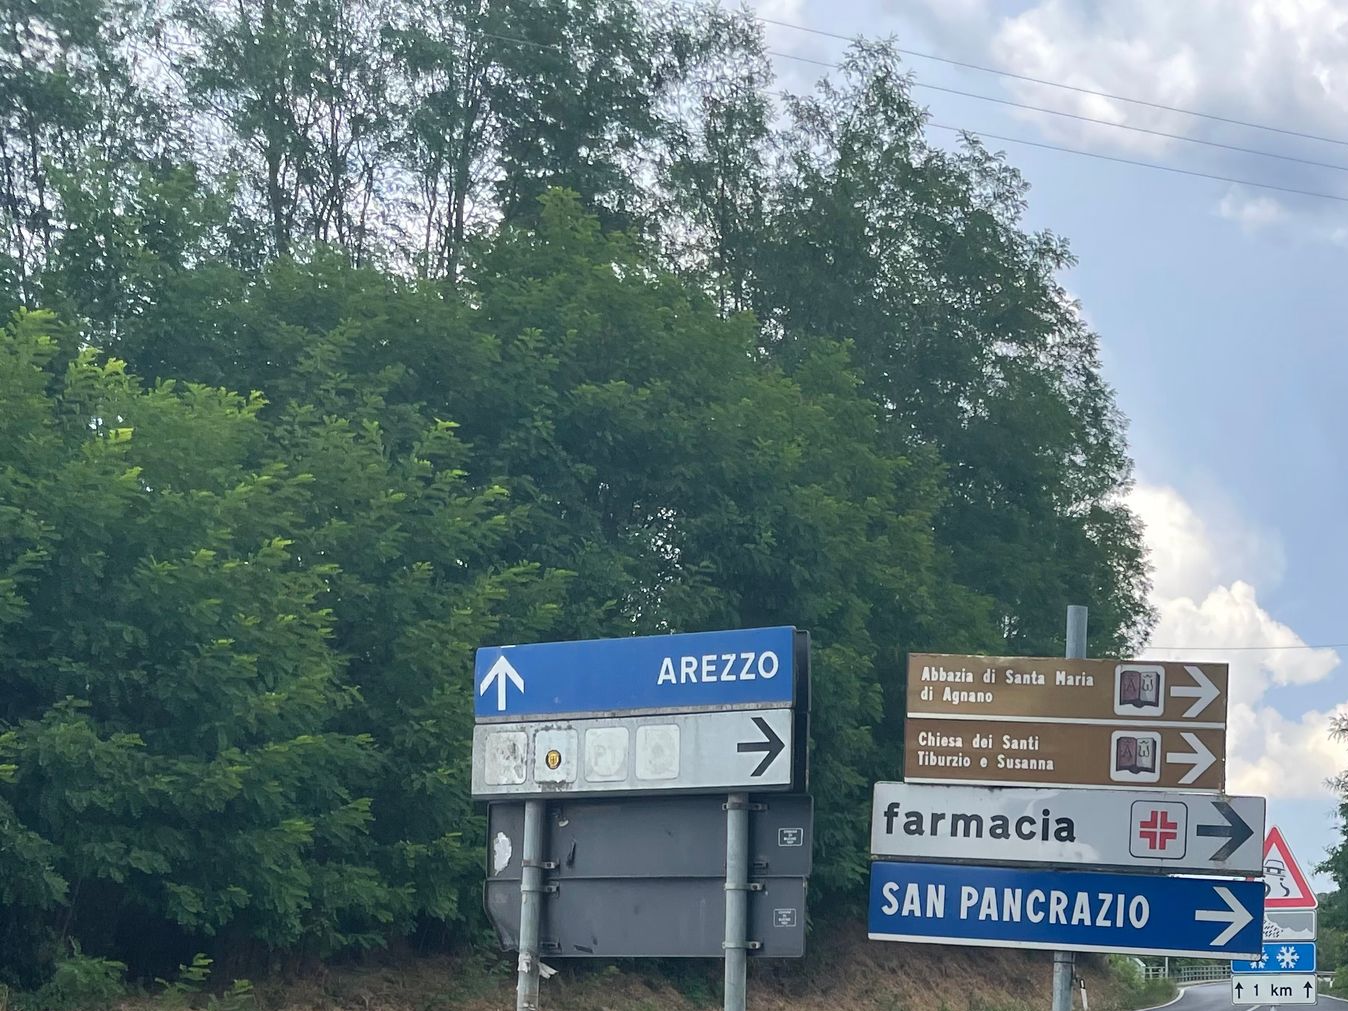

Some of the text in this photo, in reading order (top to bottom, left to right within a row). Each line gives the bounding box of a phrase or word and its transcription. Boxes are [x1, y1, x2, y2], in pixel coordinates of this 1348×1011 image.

[657, 650, 779, 685] AREZZO
[921, 666, 1094, 687] Abbazia di Santa Maria
[920, 687, 993, 705] di Agnano
[918, 731, 1040, 751] Chiesa dei Santi
[917, 751, 1054, 771] Tiburzio e Susanna
[883, 802, 1077, 843] farmacia
[880, 881, 1151, 930] SAN PANCRAZIO
[1253, 983, 1293, 997] 1 km
